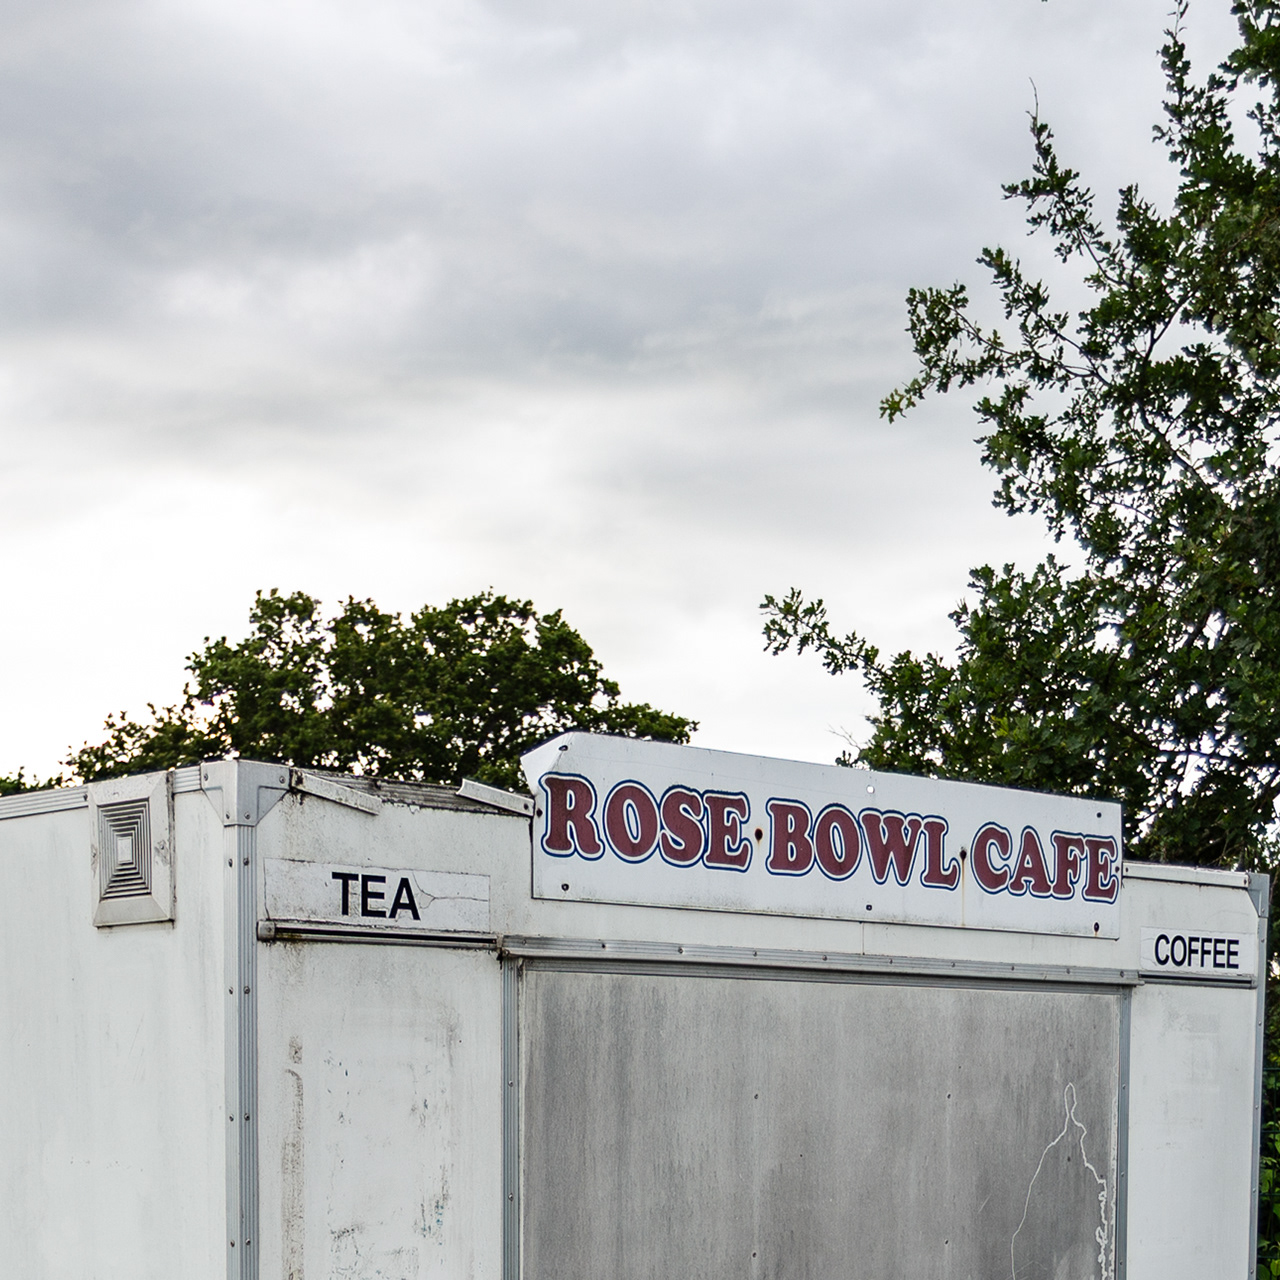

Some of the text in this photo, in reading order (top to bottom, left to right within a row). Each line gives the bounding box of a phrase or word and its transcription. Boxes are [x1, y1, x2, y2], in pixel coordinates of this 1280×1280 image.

[539, 771, 1119, 904] ROSE BOWL CAFE
[332, 871, 421, 921] TEA
[1154, 933, 1240, 969] COFFEE
